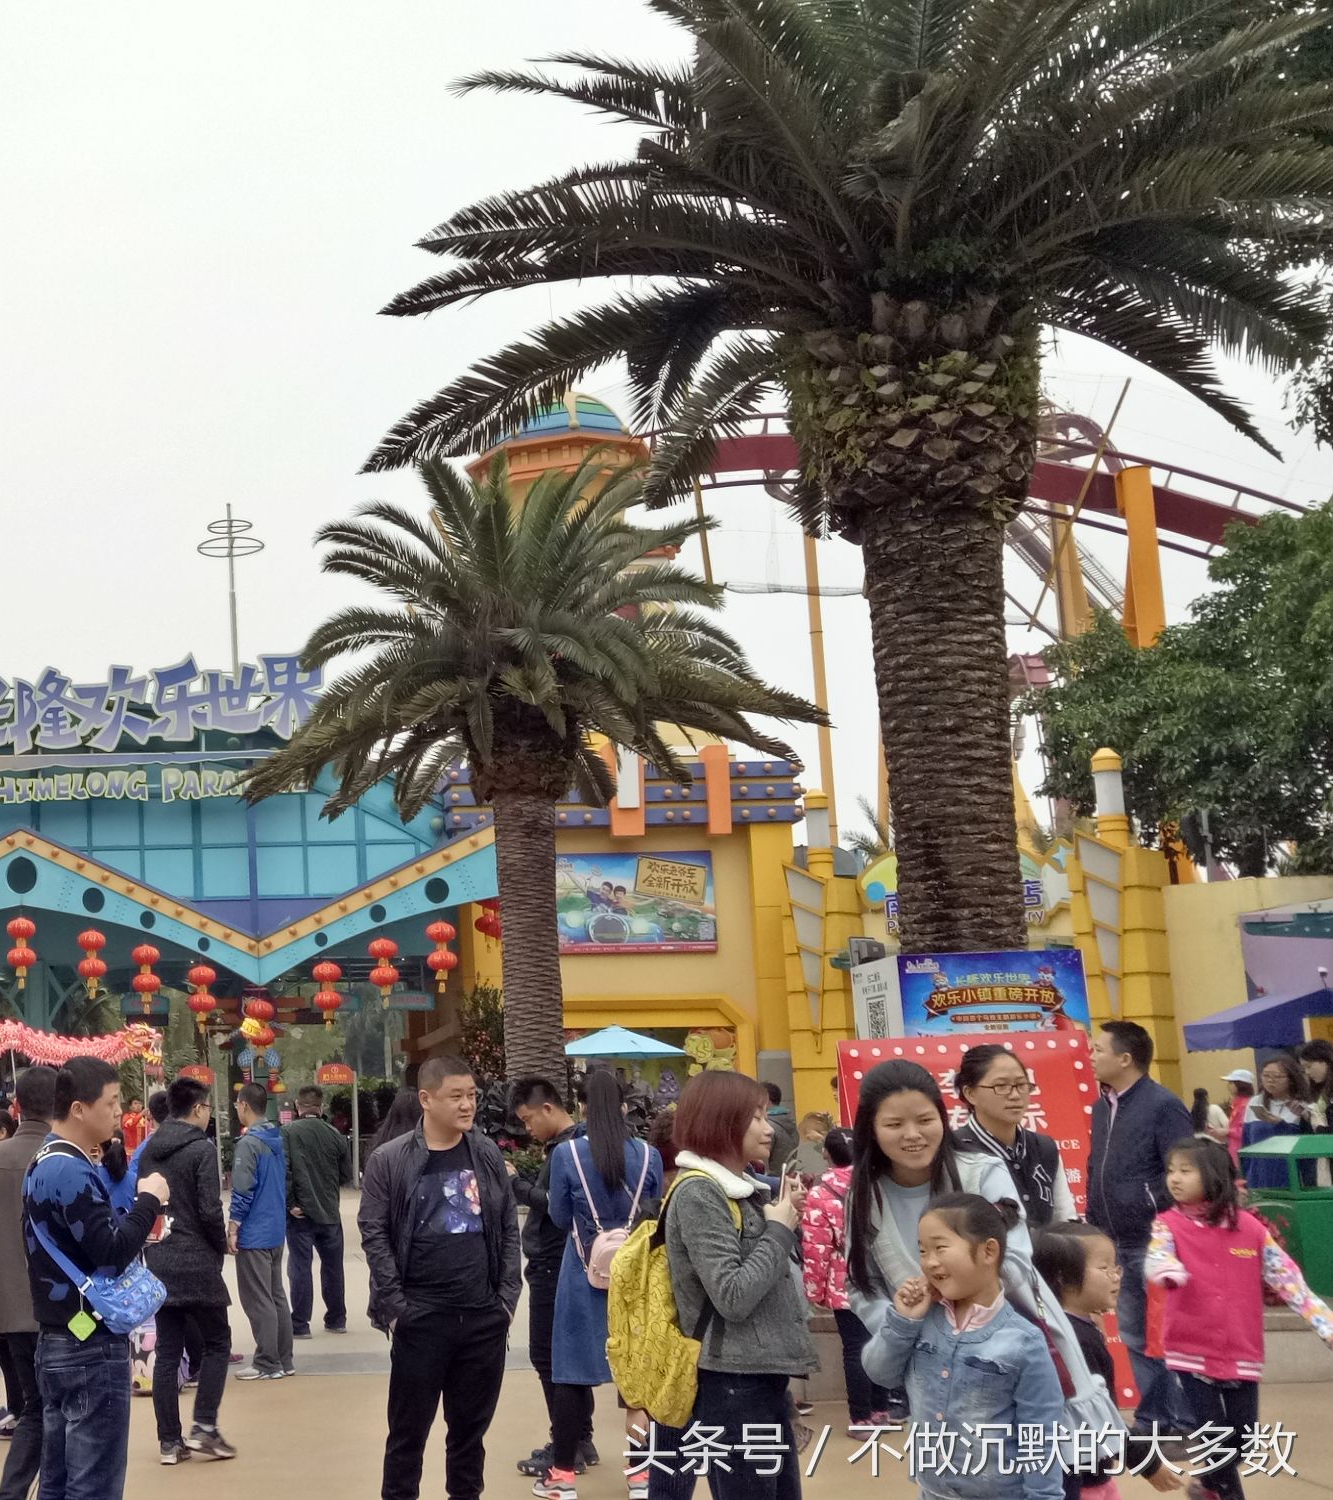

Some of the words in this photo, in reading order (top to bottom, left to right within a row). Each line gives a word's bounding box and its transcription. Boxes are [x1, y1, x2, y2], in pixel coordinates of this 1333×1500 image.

[161, 767, 309, 804] PARA
[642, 873, 699, 897] 全新开放
[931, 986, 1056, 1009] 欢乐小镇重磅开放
